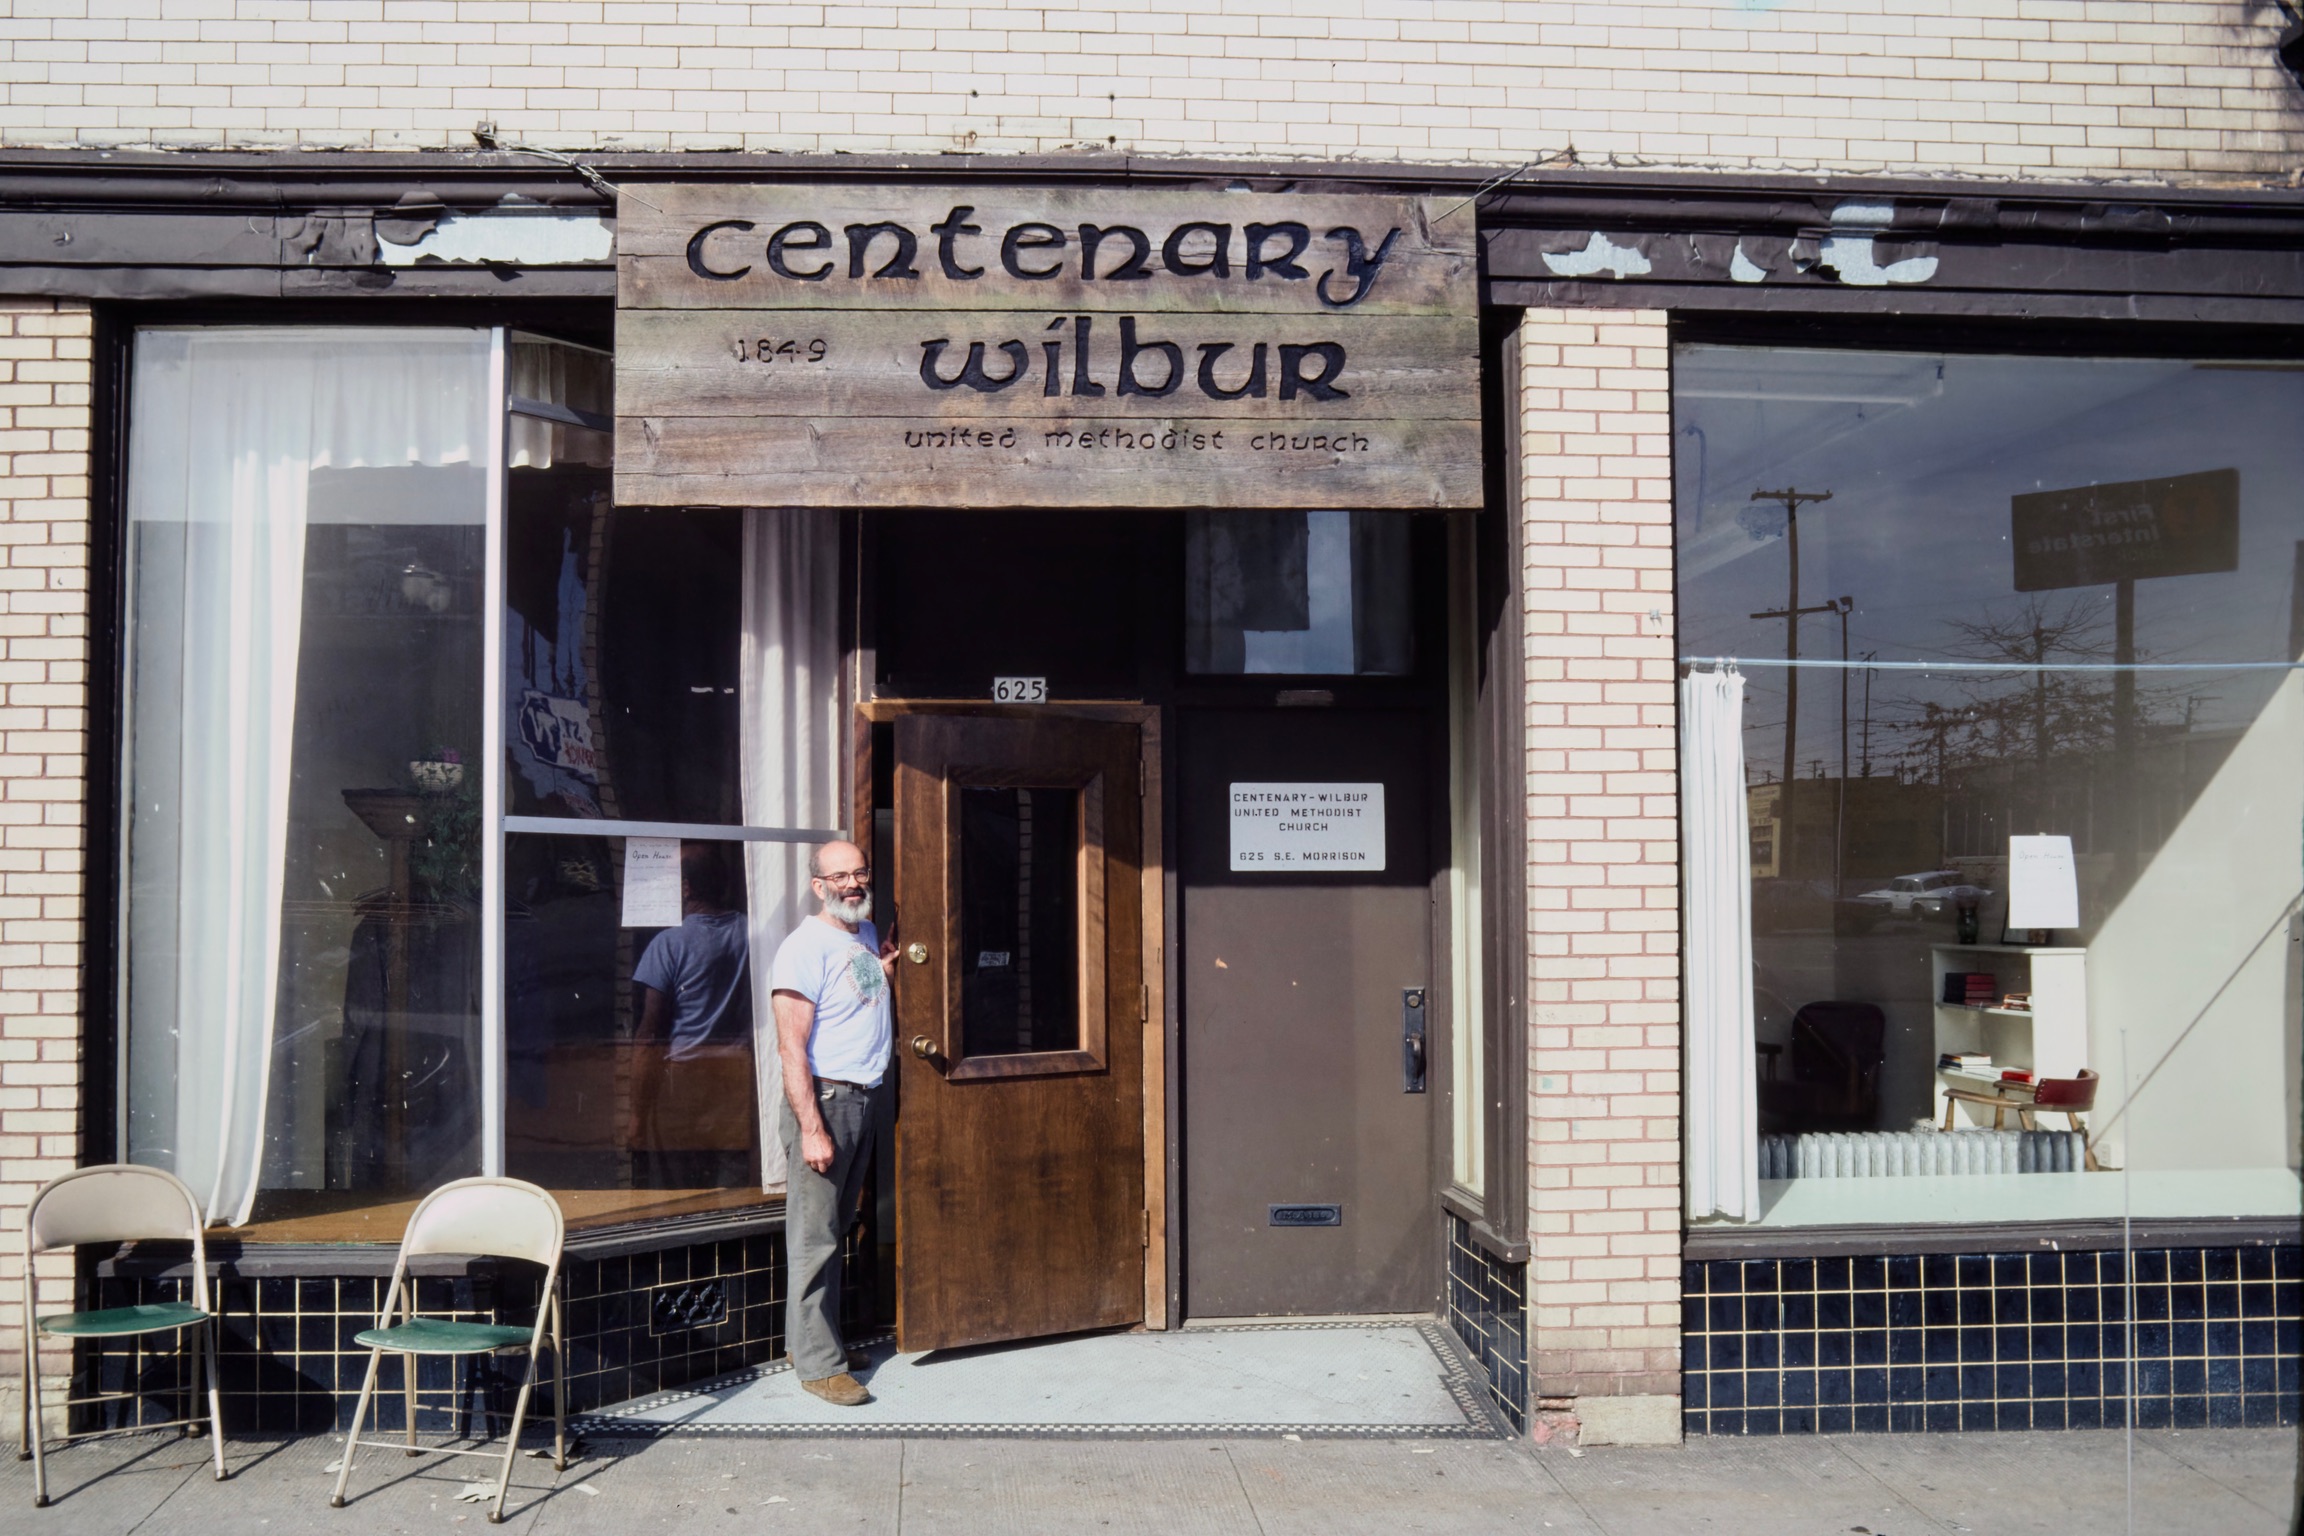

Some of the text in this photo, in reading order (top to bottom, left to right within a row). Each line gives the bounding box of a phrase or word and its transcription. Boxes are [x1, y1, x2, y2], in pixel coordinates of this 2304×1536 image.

[738, 338, 828, 364] 1849
[904, 427, 1370, 453] united methodist church
[996, 680, 1044, 701] 625
[1233, 793, 1369, 803] CENTENARY-WILBUR
[1234, 808, 1362, 817] UNITED METHODIST
[1278, 822, 1329, 832] CHURCH
[632, 849, 650, 862] Open
[1239, 852, 1367, 861] 625 S.E. MORRISON
